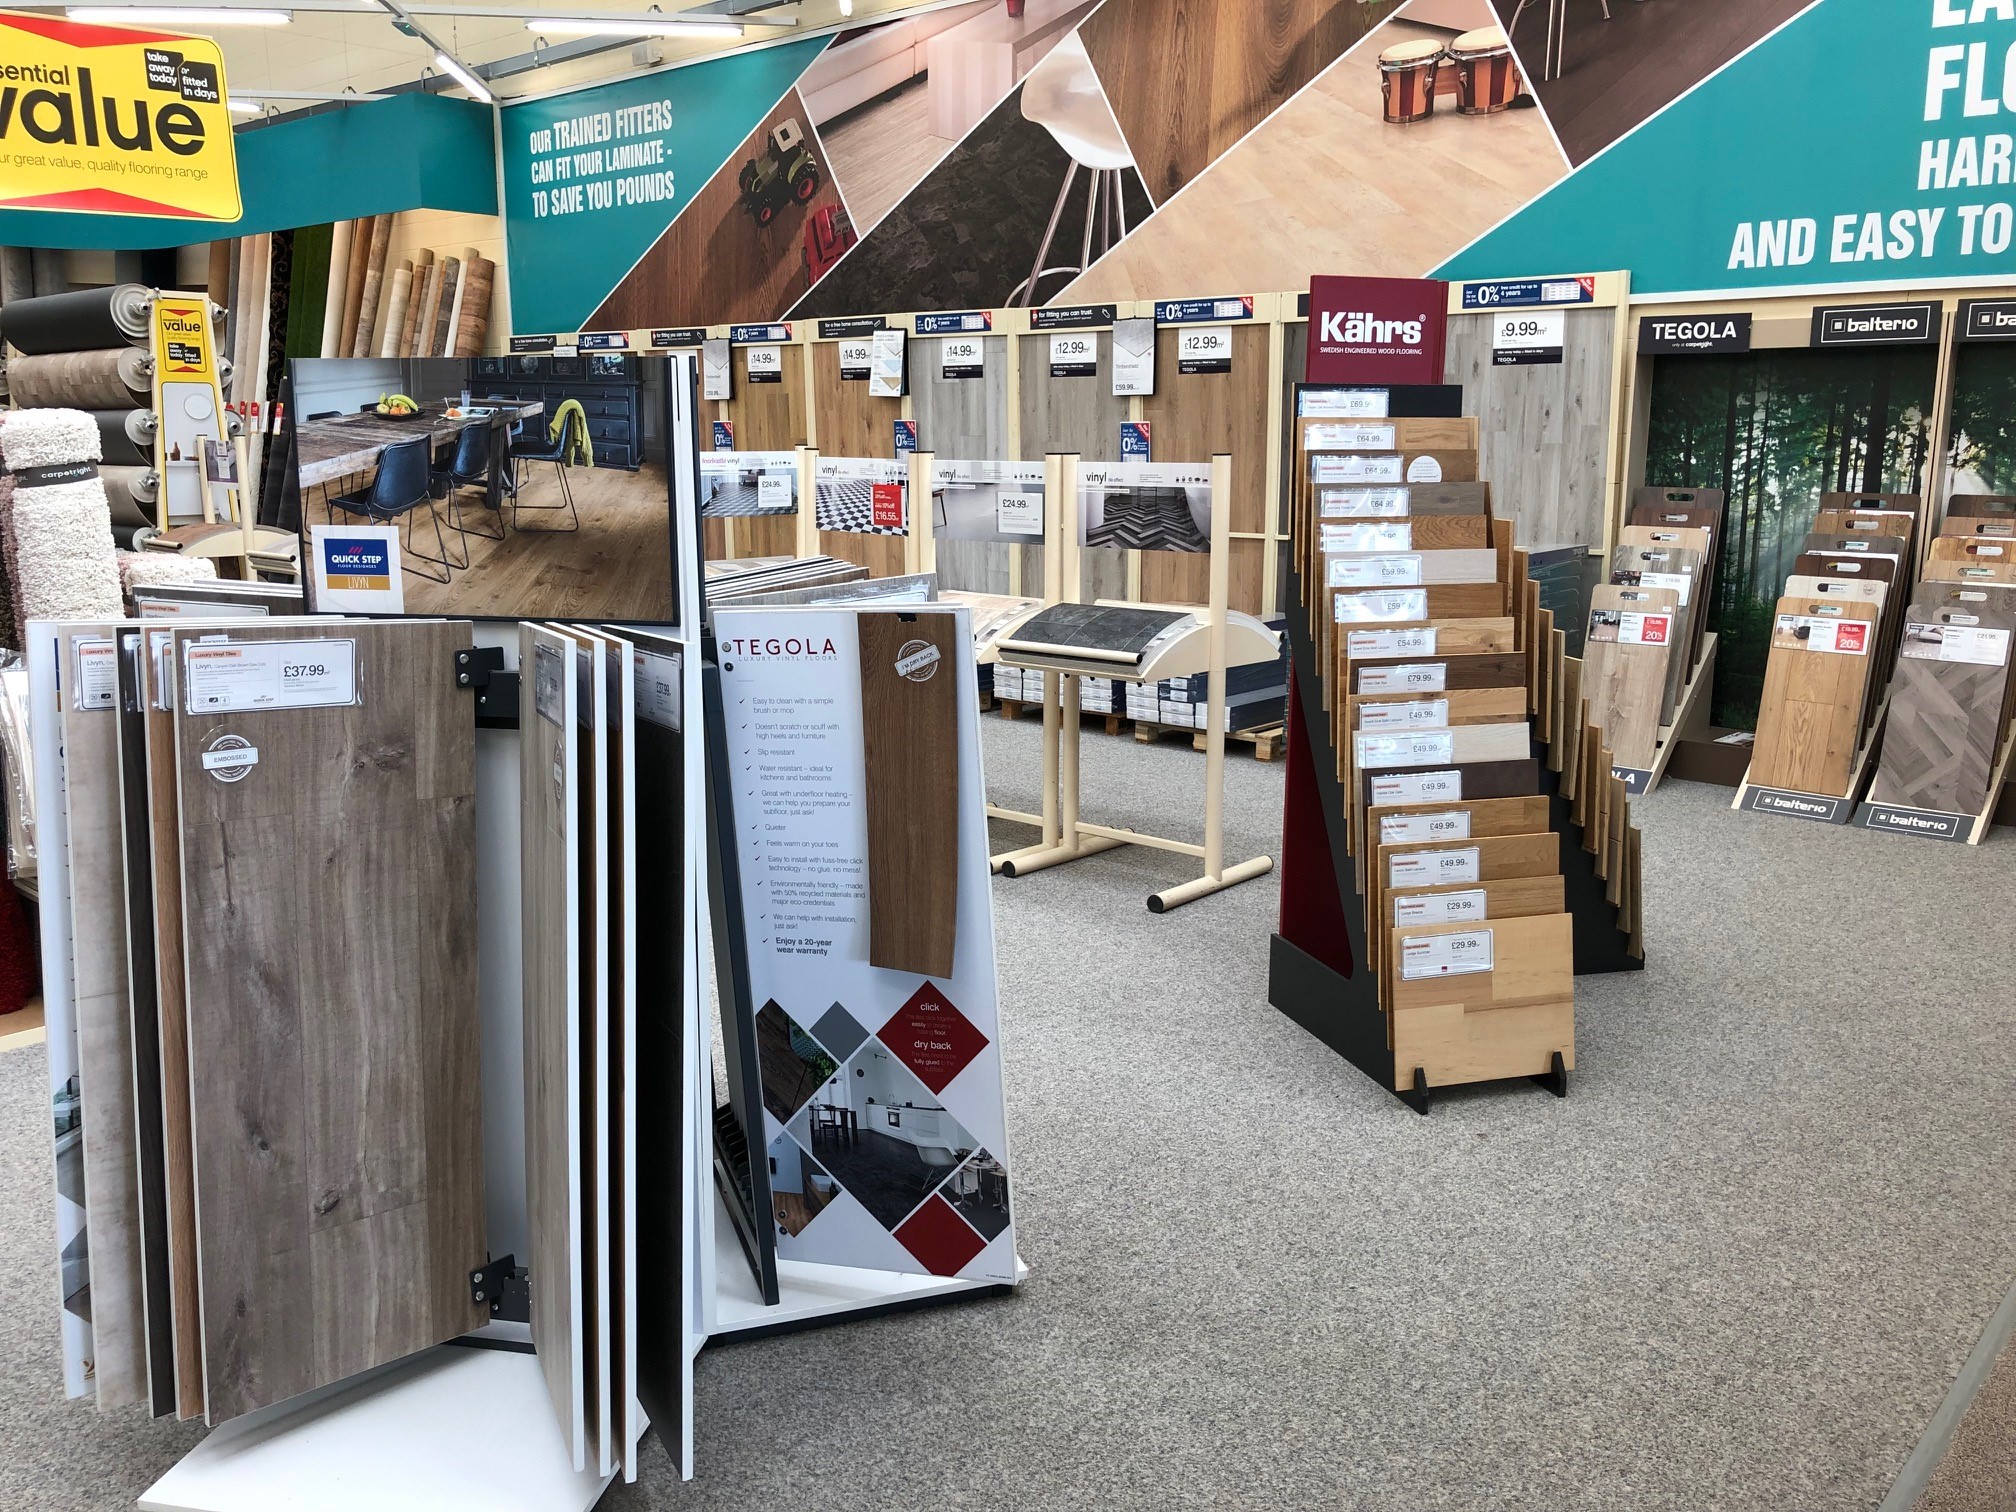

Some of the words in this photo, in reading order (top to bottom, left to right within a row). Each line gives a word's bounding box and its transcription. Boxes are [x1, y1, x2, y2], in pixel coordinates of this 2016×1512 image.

[147, 51, 169, 63] take
[148, 63, 176, 76] away
[149, 73, 178, 87] today
[182, 76, 208, 88] fitted
[184, 87, 193, 96] in
[195, 88, 218, 100] days
[530, 130, 551, 154] OUR
[553, 112, 611, 150] TRAINED
[615, 99, 672, 138] FITTERS
[531, 158, 553, 184] CAN
[556, 156, 571, 180] FIT
[574, 151, 603, 177] YOUR
[605, 139, 664, 172] LAMINATE
[1917, 133, 2016, 190] HAR
[14, 155, 46, 168] great
[48, 157, 84, 170] value,
[87, 159, 126, 175] quality
[129, 161, 173, 179] flooring
[175, 168, 209, 182] range
[532, 191, 547, 218] TO
[551, 185, 584, 216] SAVE
[586, 180, 612, 210] YOU
[617, 171, 675, 206] POUNDS
[1727, 217, 1817, 270] AND
[1830, 207, 1946, 263] EASY
[1957, 202, 2013, 255] TO
[1478, 286, 1499, 304] 0%
[1166, 304, 1182, 320] 0%
[164, 319, 201, 332] value
[924, 317, 938, 332] 0%
[1652, 321, 1736, 340] TEGOLA
[1847, 316, 1918, 333] balterio
[1122, 438, 1138, 452] 0%
[822, 466, 838, 476] vinyl
[939, 469, 956, 480] vinyl
[1086, 472, 1106, 484] vinyl
[332, 555, 360, 564] QUICK
[362, 556, 382, 564] STEP
[732, 638, 836, 656] TEGOLA
[814, 698, 834, 706] simple
[756, 732, 769, 740] high
[214, 754, 247, 762] EMBOSSED
[825, 791, 848, 799] heating
[1774, 798, 1826, 814] balterio
[1889, 814, 1948, 830] balterio
[1440, 859, 1465, 867] £49.99
[770, 880, 816, 889] Environmentally
[1446, 901, 1472, 910] £29.99
[776, 937, 796, 946] Enjoy
[804, 939, 832, 947] 20-year
[1452, 940, 1477, 949] £29.99
[796, 947, 828, 956] warranty
[920, 1002, 940, 1012] click
[914, 1040, 928, 1050] dry
[930, 1041, 951, 1050] back
